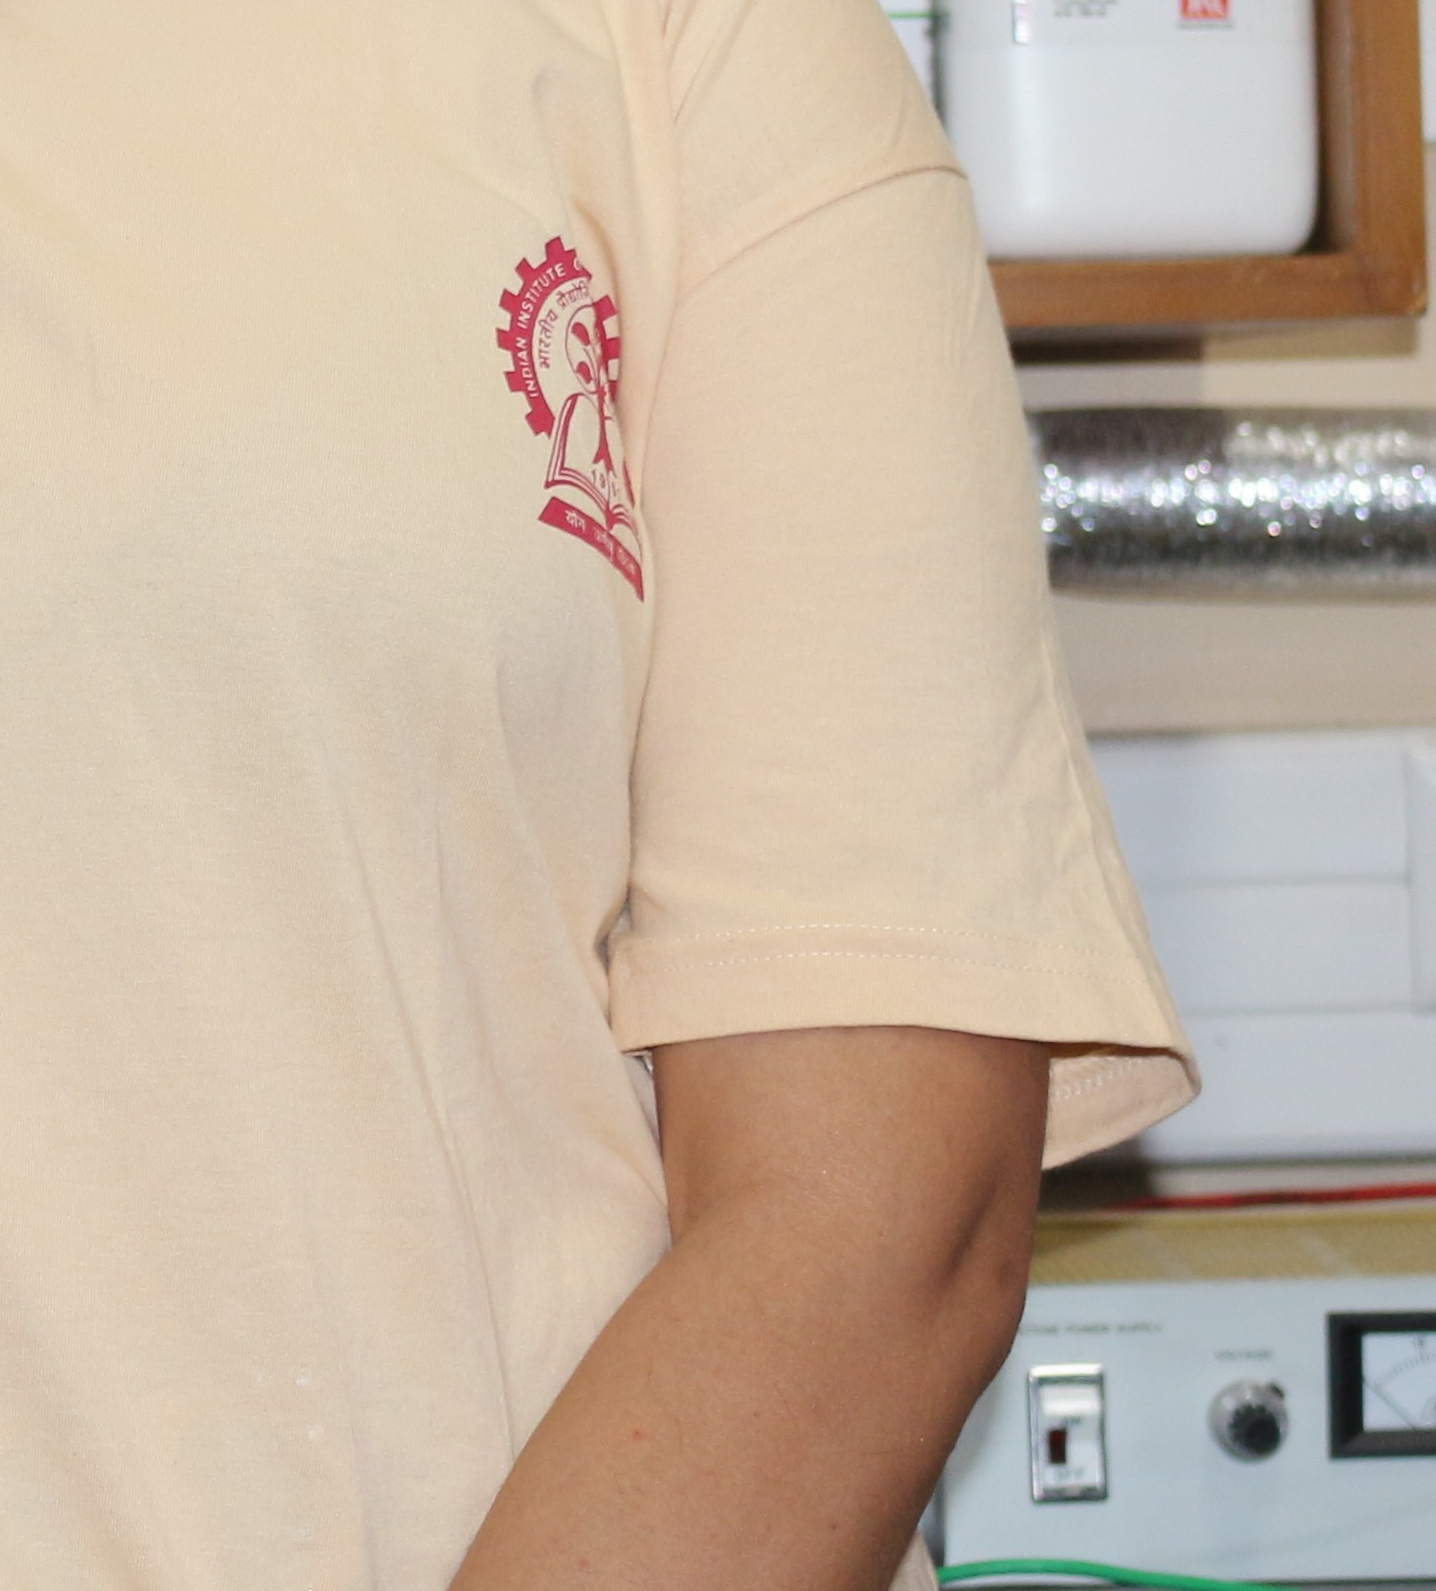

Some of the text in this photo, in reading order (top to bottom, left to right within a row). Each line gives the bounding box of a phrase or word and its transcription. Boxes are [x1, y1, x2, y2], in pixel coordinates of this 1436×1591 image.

[517, 262, 567, 330] INSTITUTE
[516, 337, 539, 398] INDIAN
[538, 309, 558, 369] भारतीय
